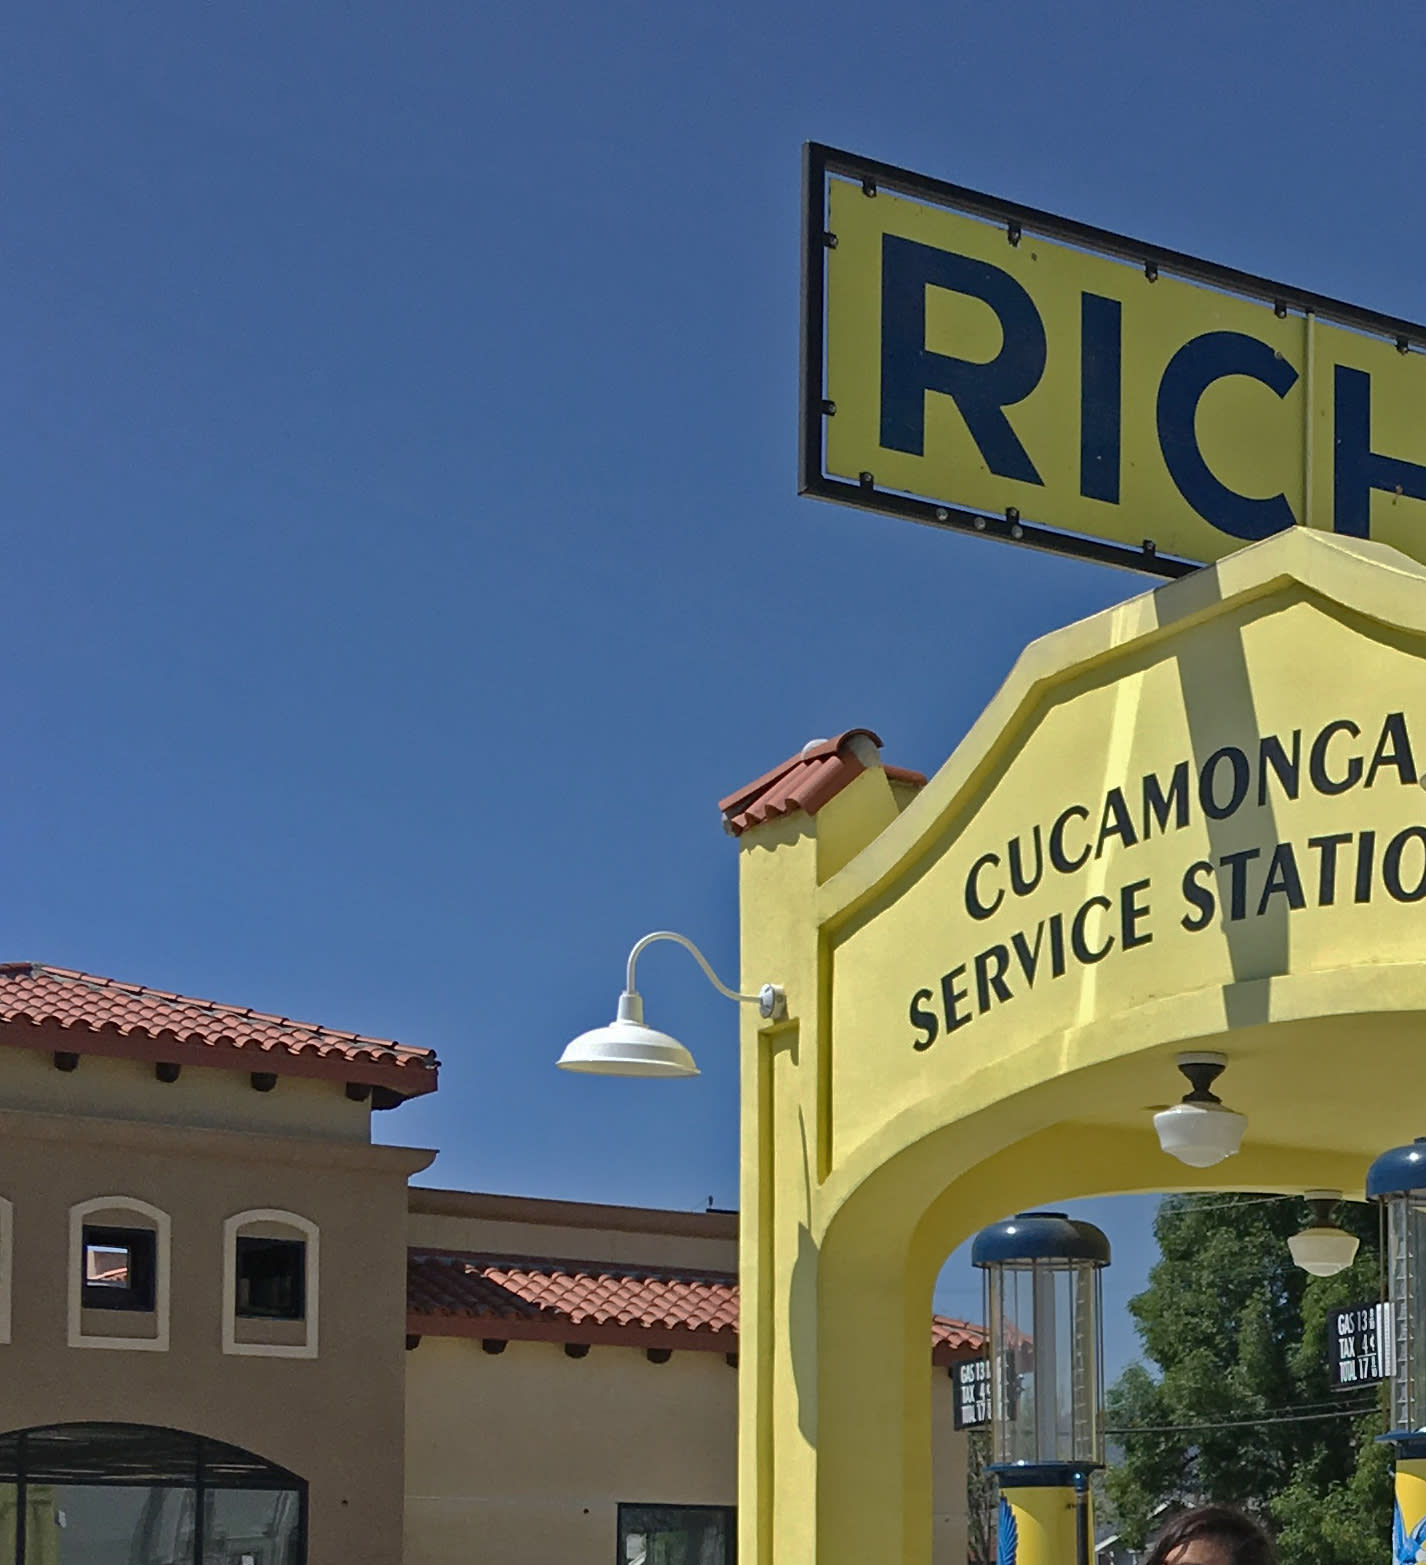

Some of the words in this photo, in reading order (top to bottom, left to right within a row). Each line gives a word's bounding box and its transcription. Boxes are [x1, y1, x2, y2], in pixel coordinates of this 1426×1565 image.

[964, 711, 1419, 922] CUCAMONGA
[909, 878, 1154, 1052] SERVICE
[1338, 1312, 1355, 1335] GAS
[1338, 1336, 1356, 1359] TAX
